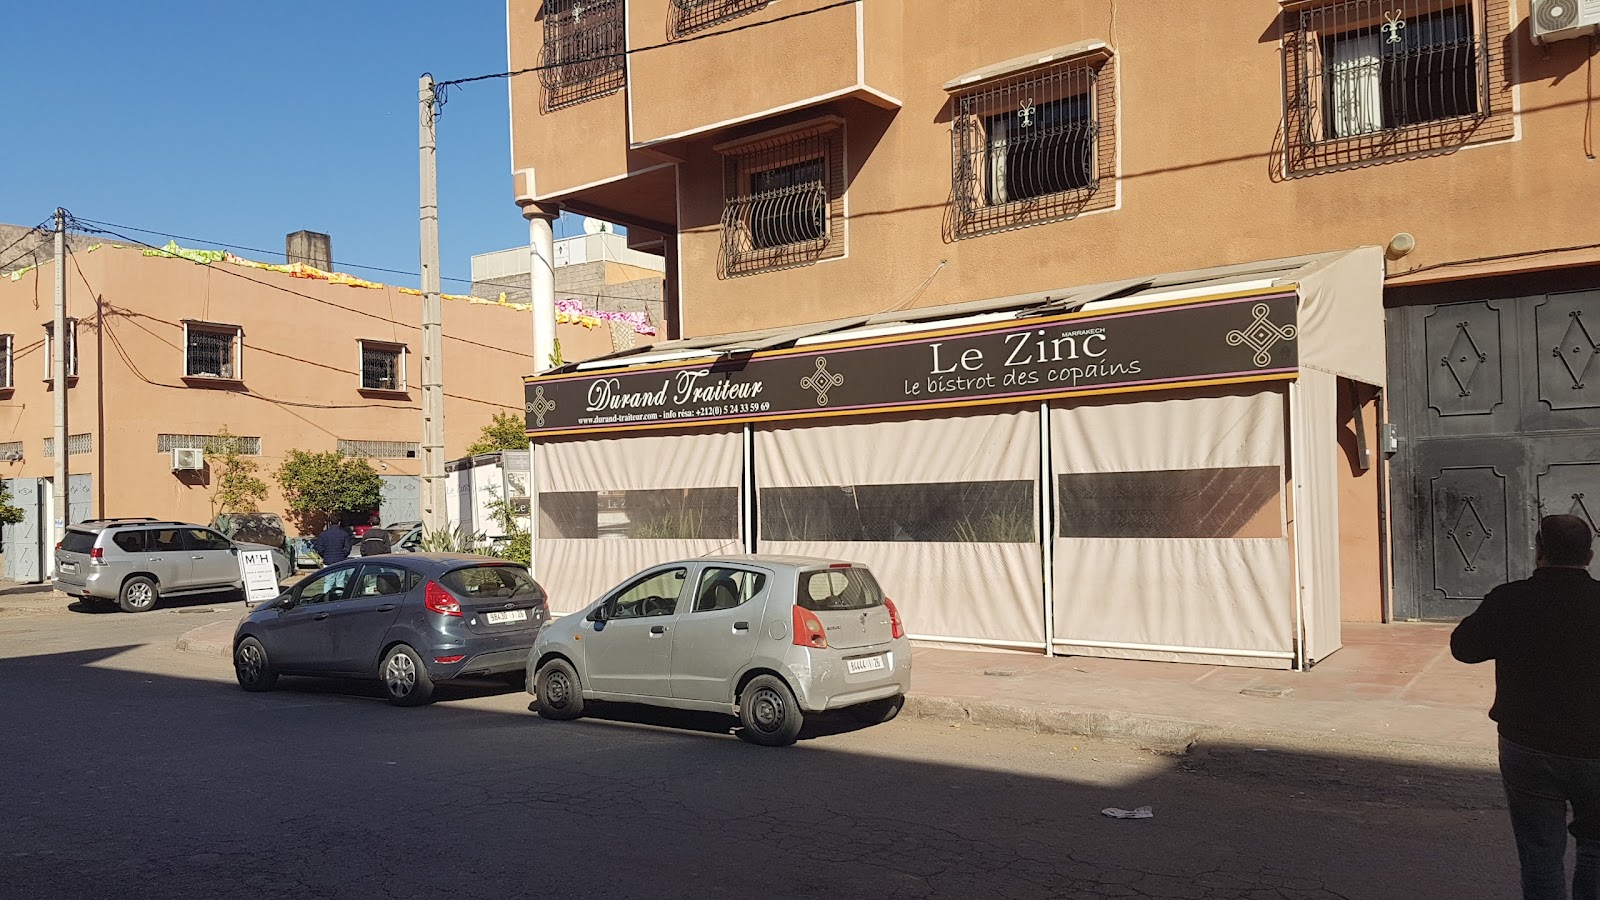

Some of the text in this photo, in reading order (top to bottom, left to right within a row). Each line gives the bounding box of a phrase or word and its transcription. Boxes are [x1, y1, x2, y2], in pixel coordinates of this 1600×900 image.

[929, 329, 1108, 374] Le Zinc
[1061, 328, 1106, 337] MARRAKECH
[586, 369, 763, 412] Durand Traiteur
[904, 358, 1142, 396] le bistrot des copains
[578, 412, 658, 424] www.durand-traiteur.com
[663, 409, 677, 419] info
[677, 408, 695, 418] résa:
[695, 405, 722, 416] +212(0)
[723, 405, 728, 414] 5
[729, 404, 739, 414] 24
[740, 403, 749, 413] 33
[750, 402, 759, 412] 59
[760, 401, 770, 411] 69
